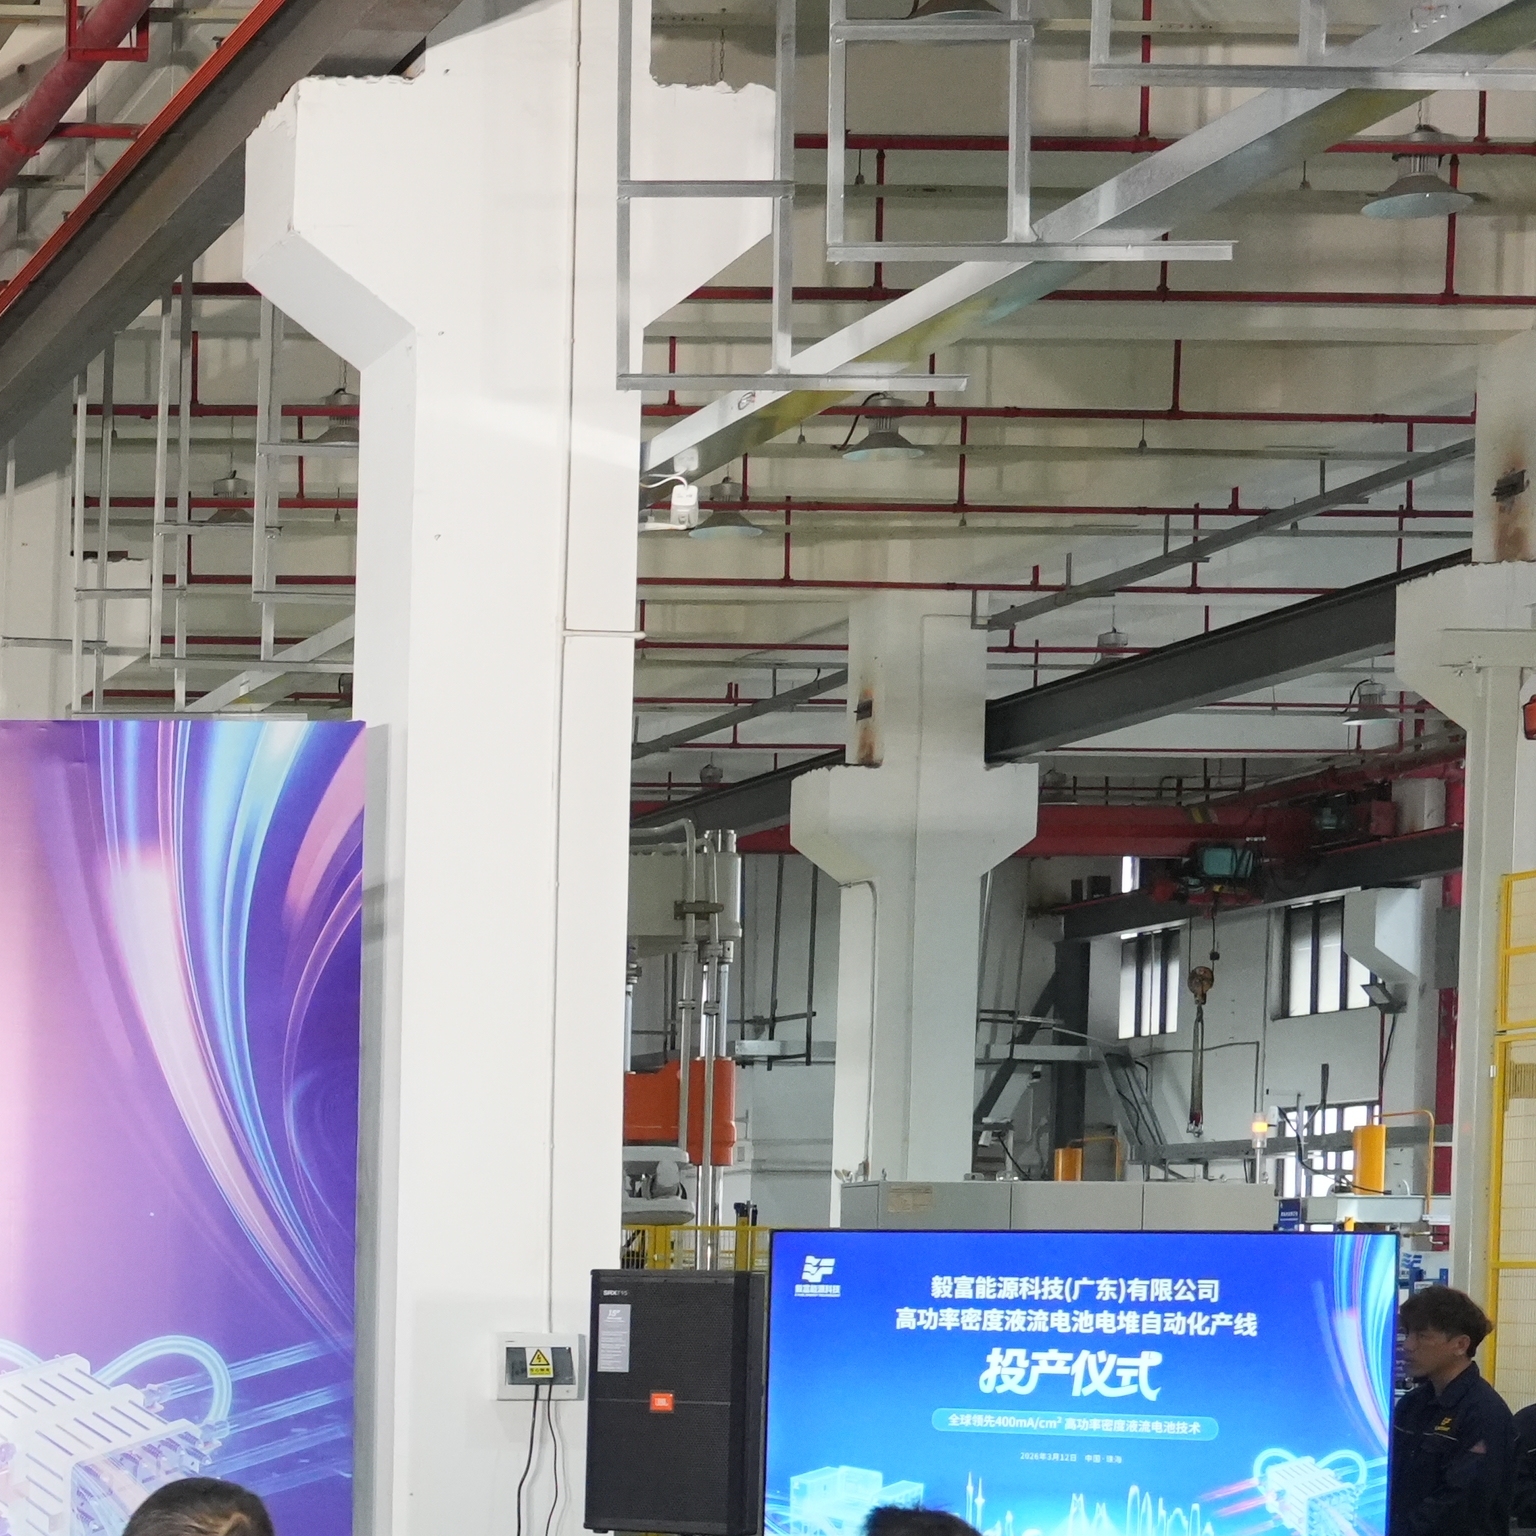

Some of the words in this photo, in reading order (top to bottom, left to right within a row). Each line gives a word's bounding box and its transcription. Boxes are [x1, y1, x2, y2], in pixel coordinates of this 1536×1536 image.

[930, 1274, 1221, 1305] 毅富能源科技(广东)有限公司
[895, 1306, 1259, 1339] 高功率密度液流电池电堆自动化产线
[978, 1347, 1163, 1402] 投产仪式
[1064, 1417, 1202, 1436] 高功率密度液流电池技术
